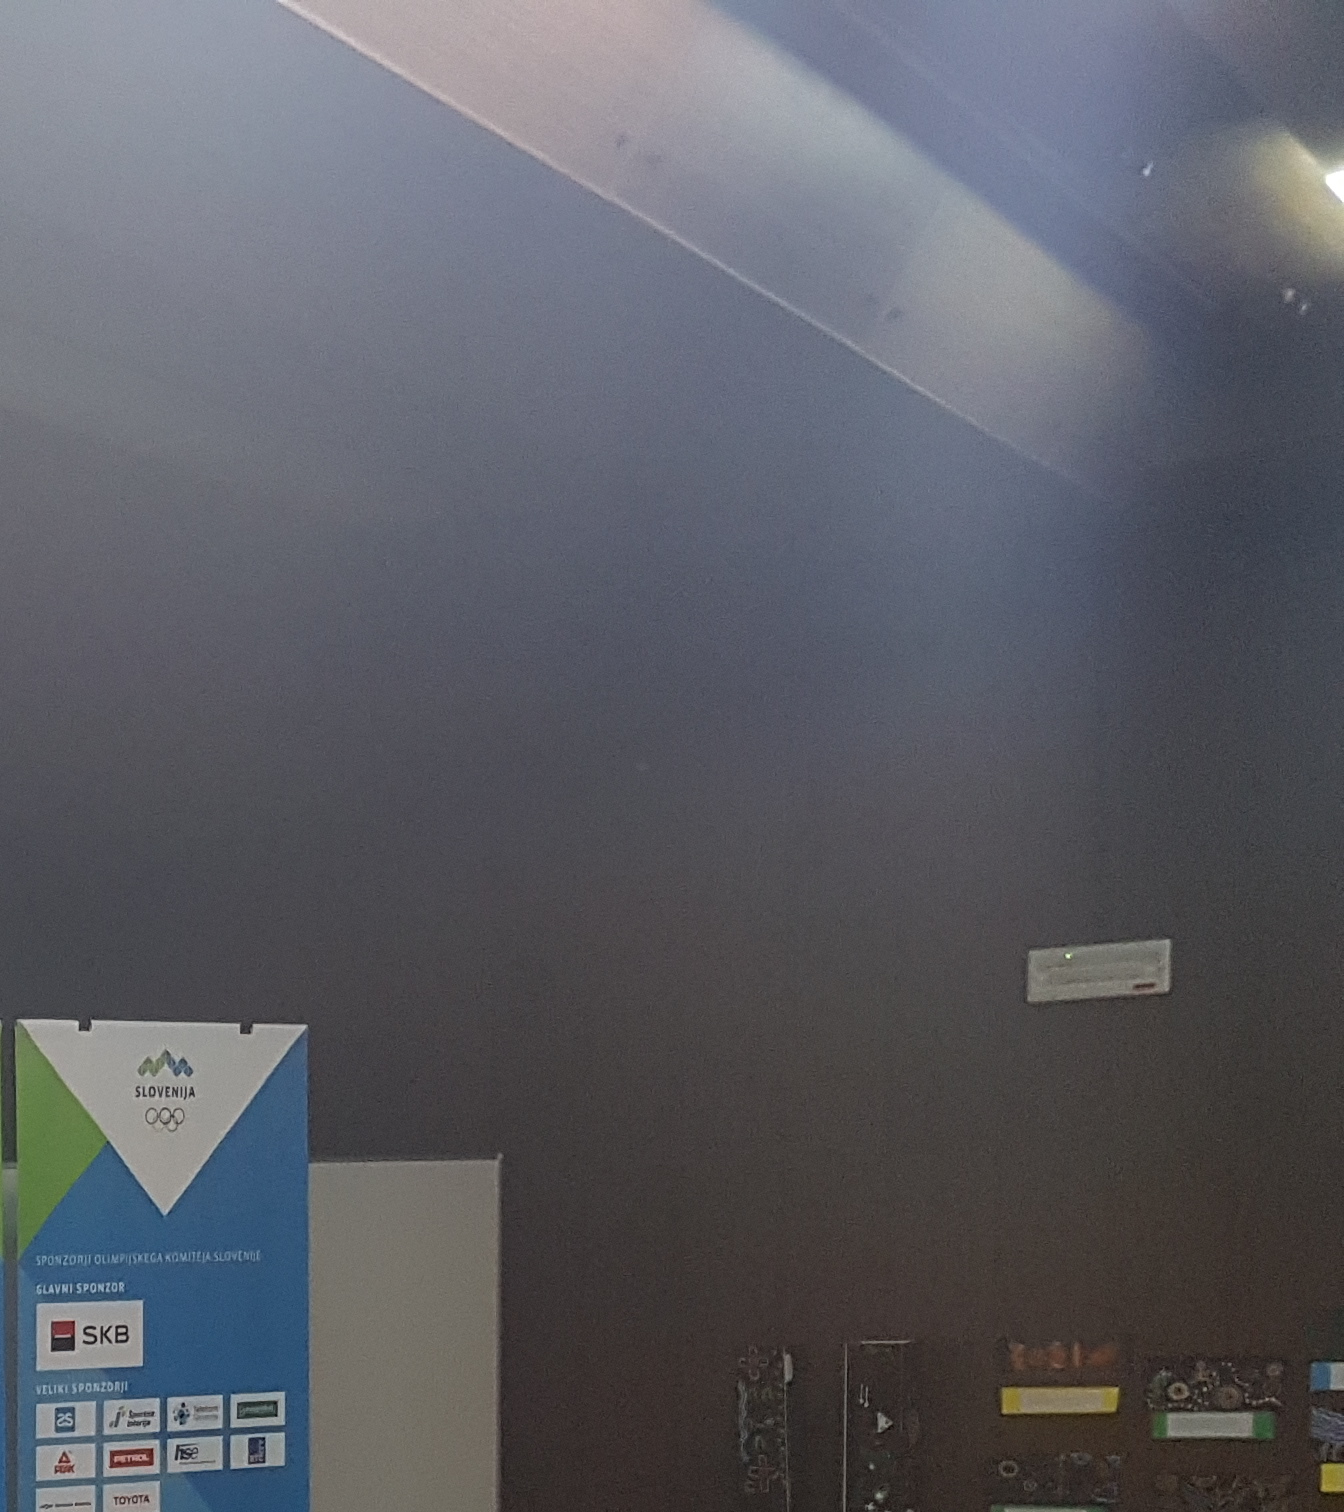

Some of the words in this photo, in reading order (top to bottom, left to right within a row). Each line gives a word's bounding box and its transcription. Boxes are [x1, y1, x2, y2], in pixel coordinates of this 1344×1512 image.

[134, 1086, 196, 1101] SLOVENIJA
[36, 1254, 91, 1267] SPONZORJI
[94, 1252, 162, 1266] OLIMPIJSKEGA
[165, 1251, 211, 1263] KOMITEJA
[213, 1250, 261, 1262] SLOVENIJE
[36, 1283, 72, 1295] GLAVNI
[76, 1281, 125, 1294] SPONZOR
[82, 1325, 129, 1345] SKB
[36, 1385, 68, 1395] VELIKI
[72, 1381, 128, 1394] SPONZORJI
[113, 1494, 150, 1506] TOYOTA
